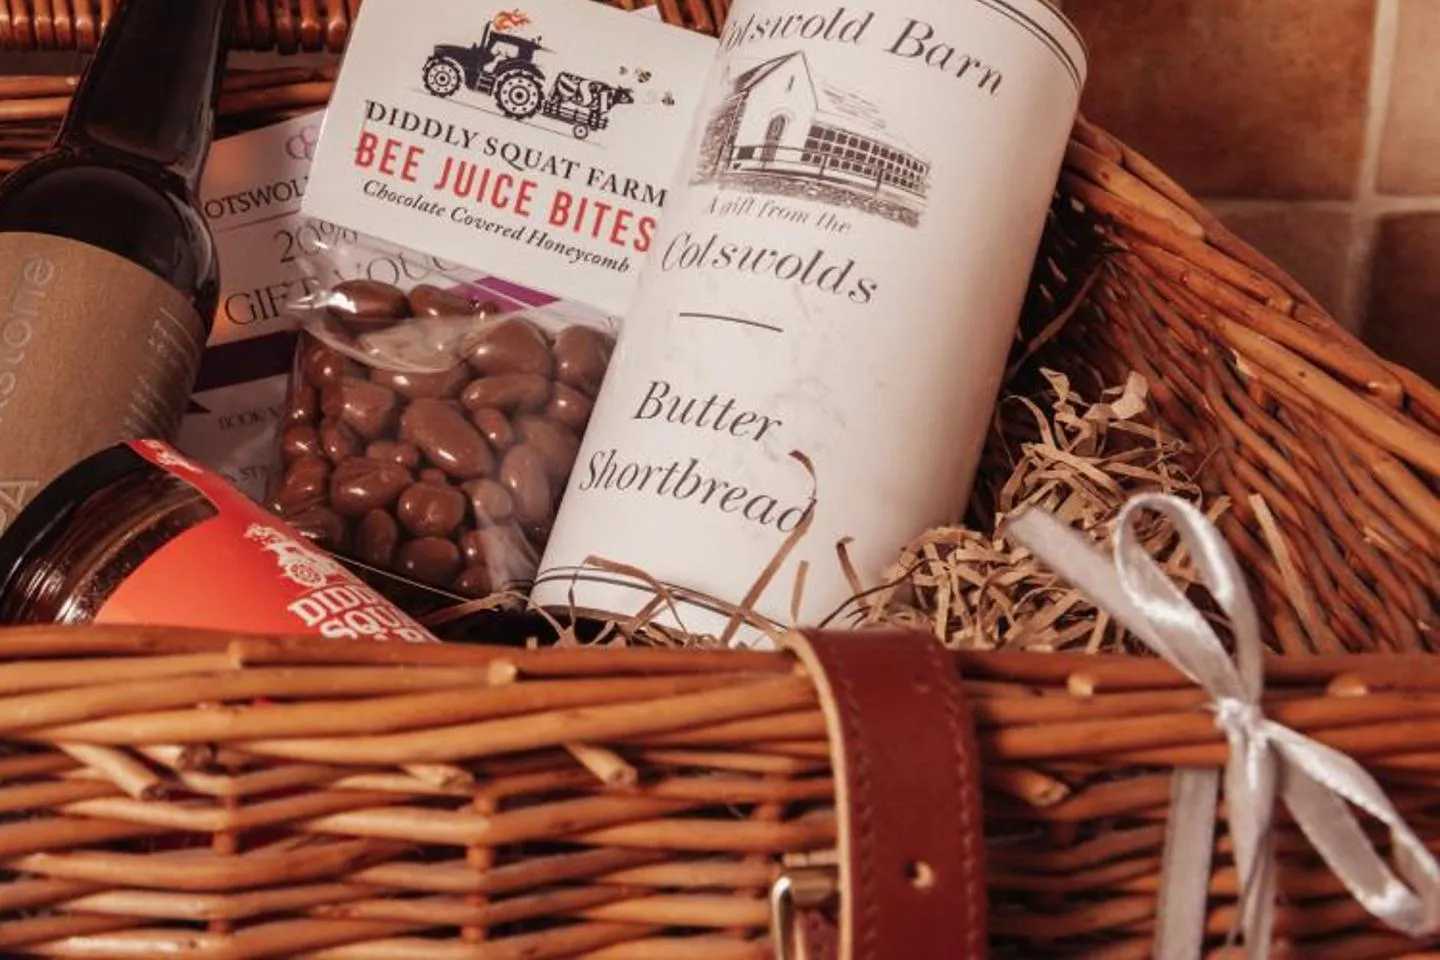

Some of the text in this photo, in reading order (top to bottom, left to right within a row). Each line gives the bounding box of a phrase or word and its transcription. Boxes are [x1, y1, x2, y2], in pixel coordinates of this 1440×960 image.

[884, 16, 1003, 96] Barn
[354, 131, 659, 253] BEE JUICE BITES
[364, 100, 669, 208] DIDDLY SQUAT FARM
[204, 176, 309, 219] OTSWOL
[363, 179, 632, 273] Chocolate Covered Honeycomb
[758, 199, 810, 224] from
[816, 212, 852, 233] the
[225, 276, 320, 326] GIFT
[661, 231, 878, 304] Cotswolds
[634, 380, 782, 442] Butter
[580, 448, 816, 533] Shortbread
